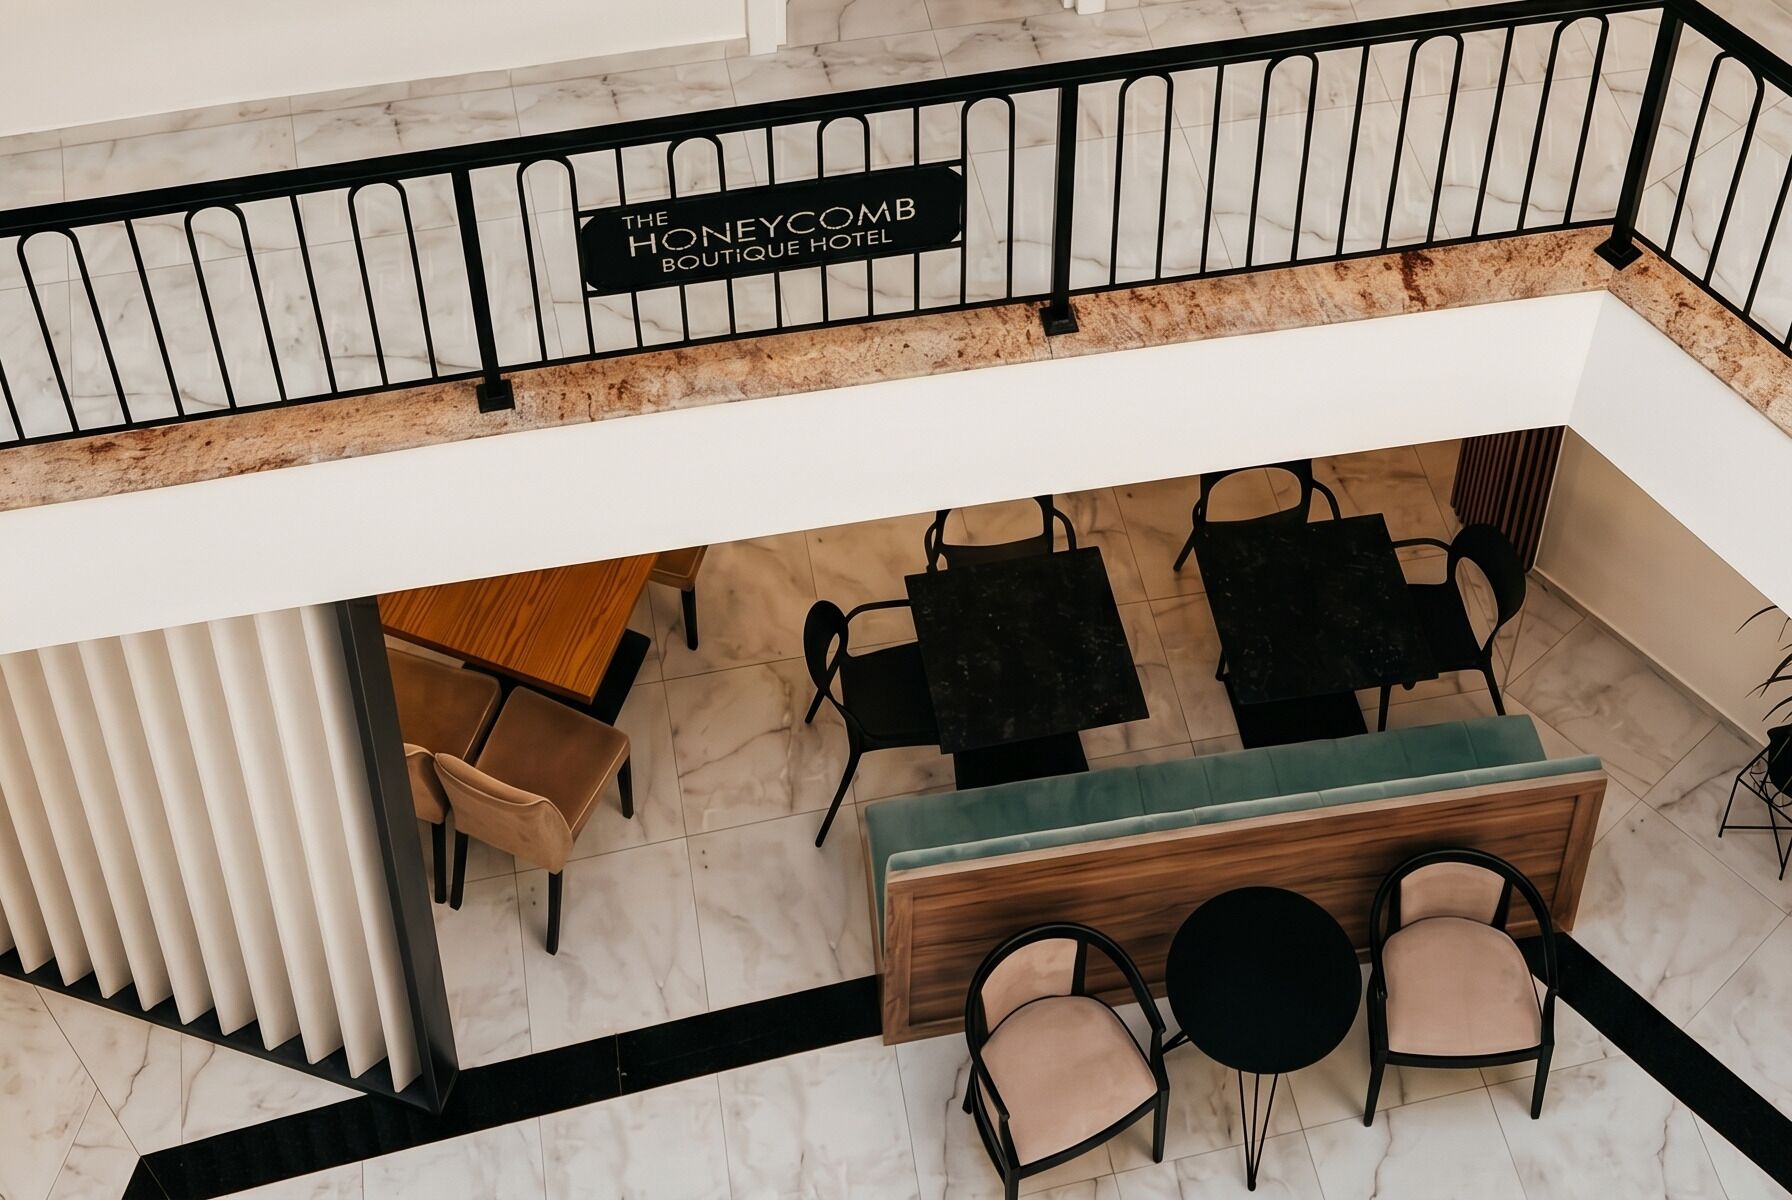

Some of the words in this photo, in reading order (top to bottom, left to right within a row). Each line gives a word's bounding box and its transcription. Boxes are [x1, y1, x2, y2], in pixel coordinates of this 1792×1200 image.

[621, 211, 668, 230] THE
[628, 197, 917, 257] HONEYCOMB
[809, 229, 893, 252] HOTEL
